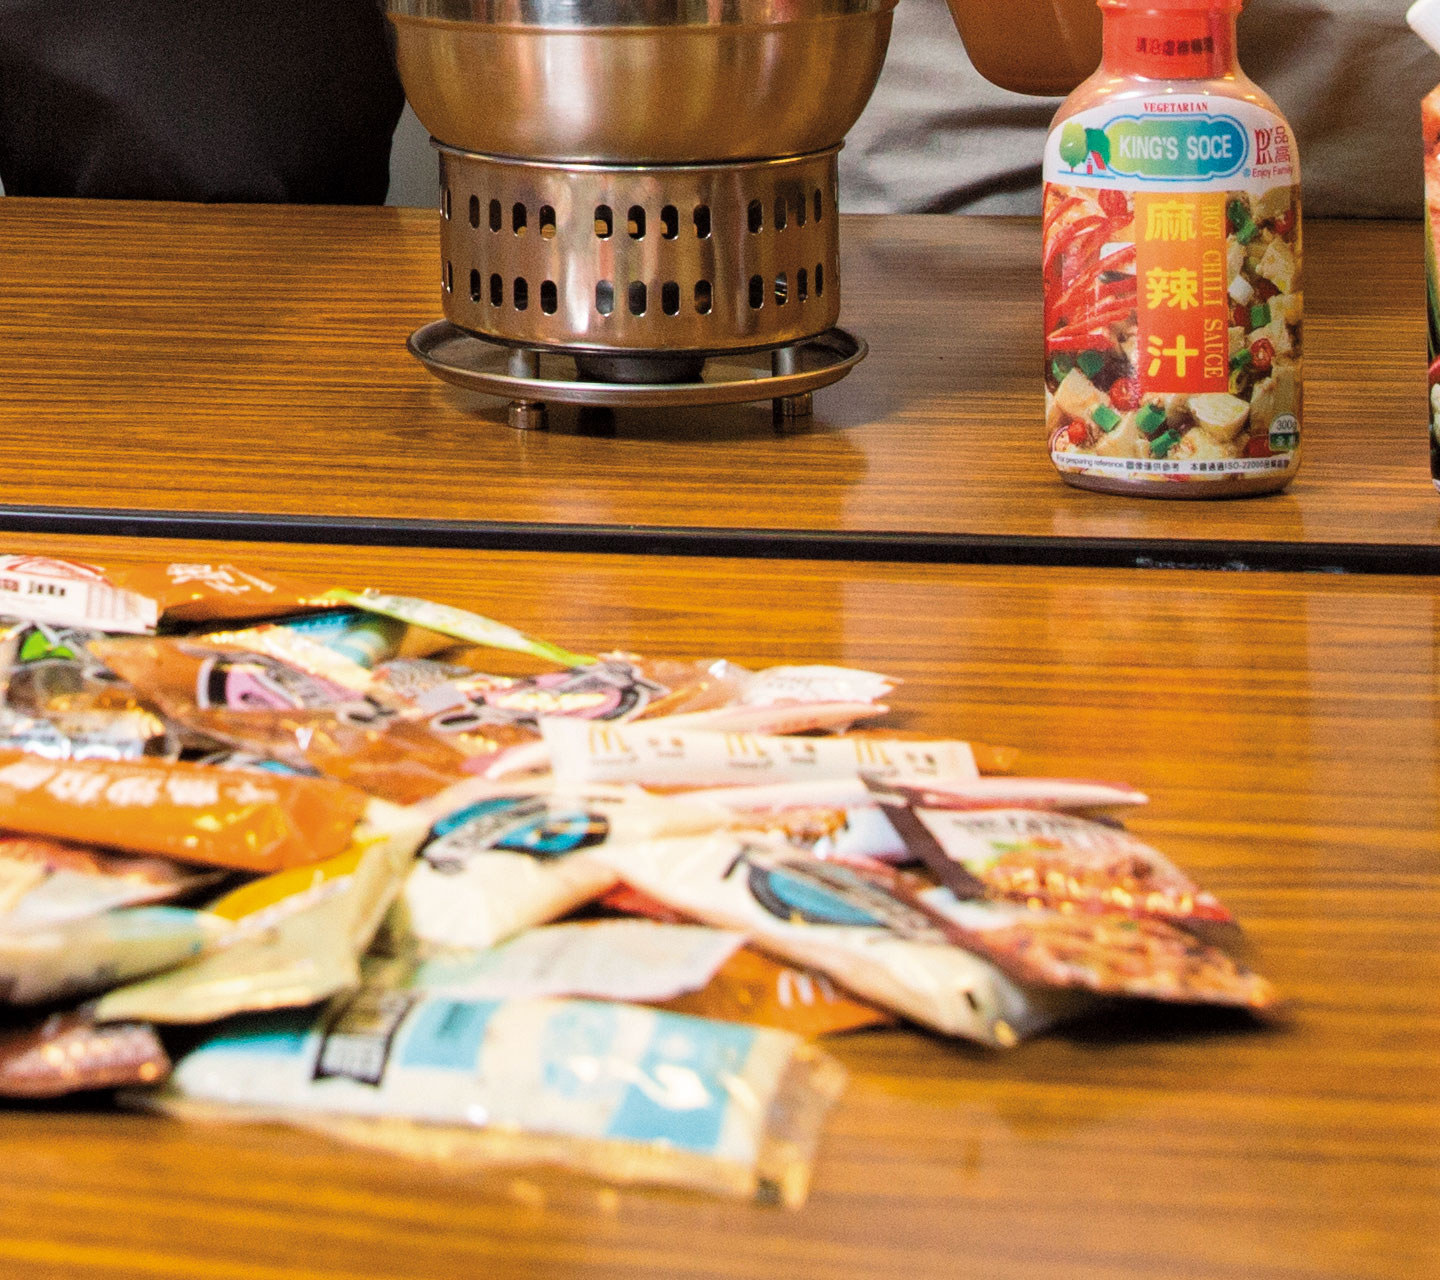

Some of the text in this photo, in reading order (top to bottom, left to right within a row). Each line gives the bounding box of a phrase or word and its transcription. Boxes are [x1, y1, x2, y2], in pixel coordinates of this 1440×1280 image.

[1143, 101, 1208, 112] VEGETARIAN
[1119, 134, 1232, 161] KING'S SOCE
[1143, 200, 1199, 380] 麻辣汁
[1203, 248, 1223, 307] CHILI
[1203, 316, 1224, 380] SAUCE
